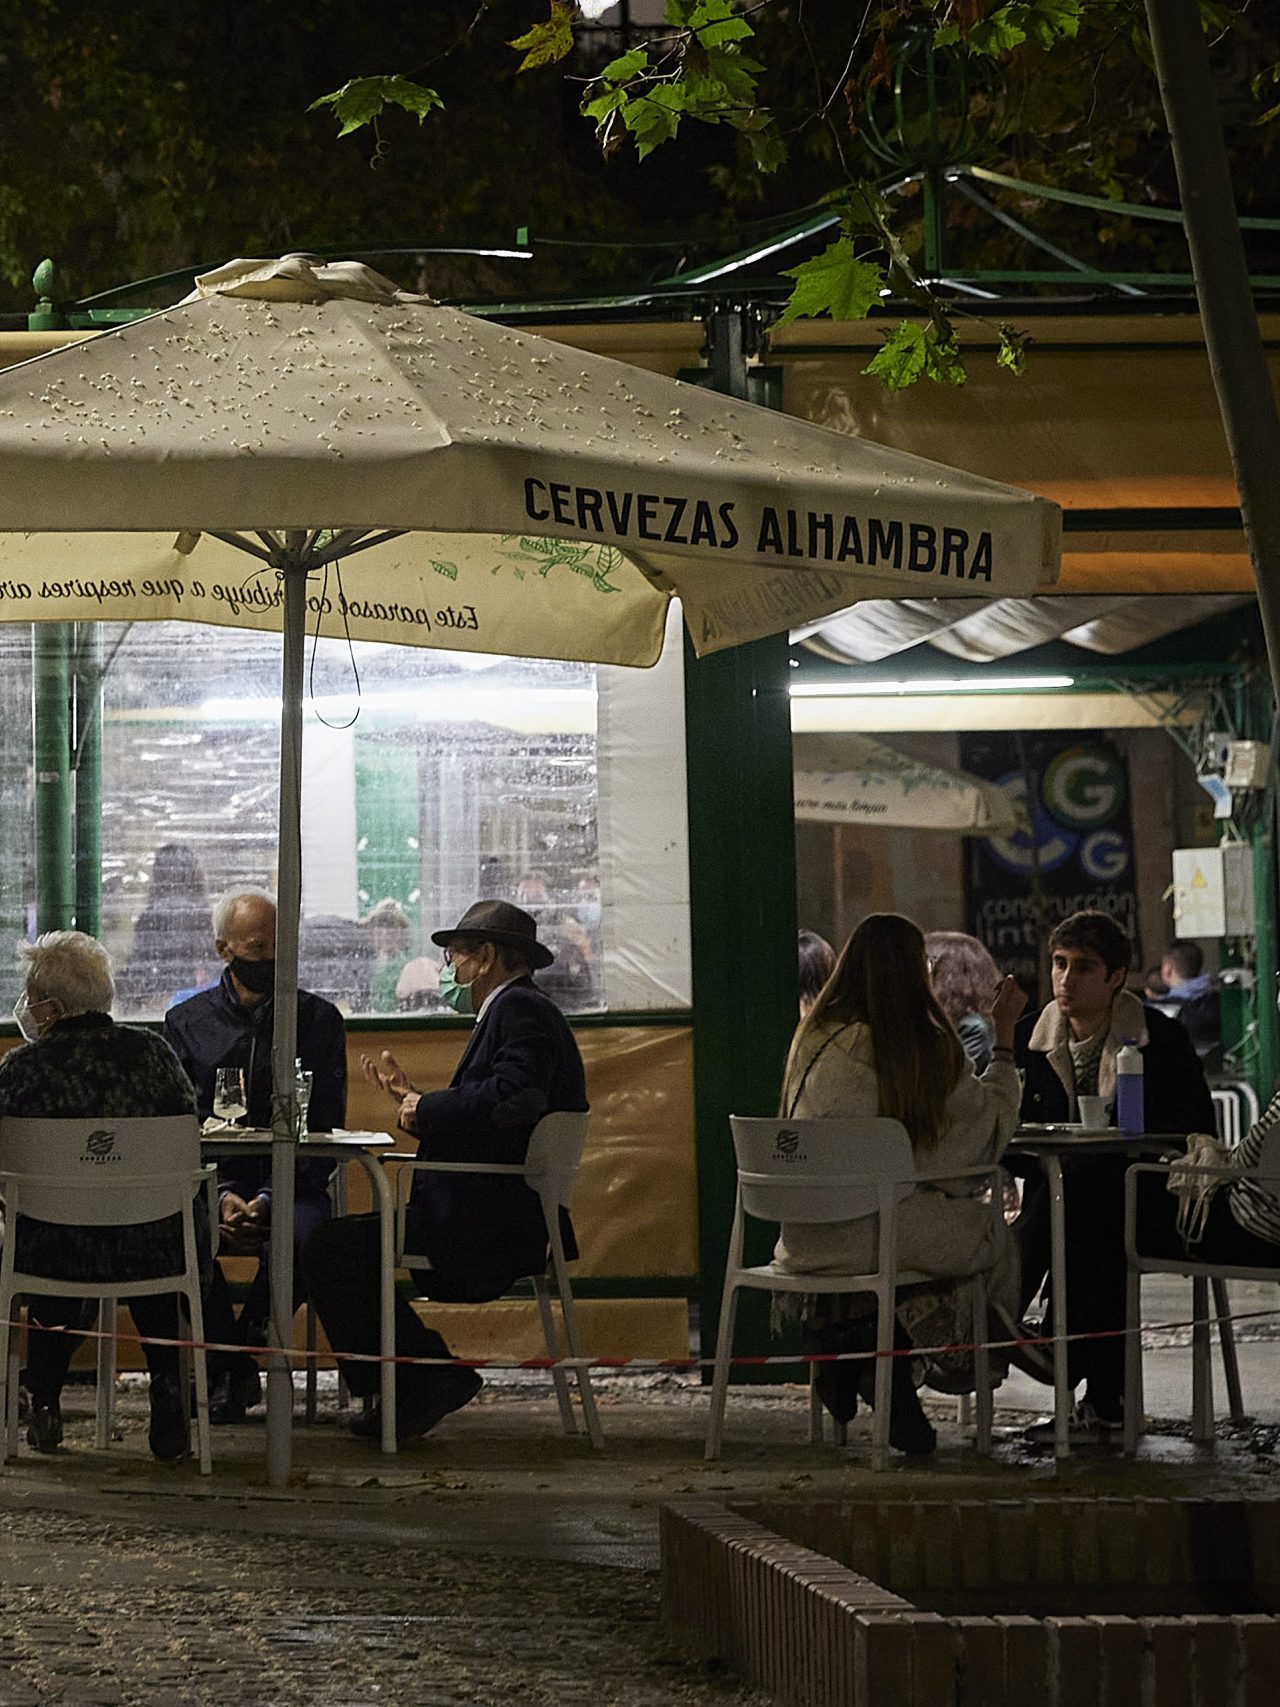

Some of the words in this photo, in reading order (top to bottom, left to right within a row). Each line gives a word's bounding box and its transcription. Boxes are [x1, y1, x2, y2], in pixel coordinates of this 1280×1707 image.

[524, 477, 739, 549] CERVEZAS
[756, 507, 993, 582] ALHAMBRA
[1052, 755, 1117, 820] G
[1081, 829, 1128, 879] G
